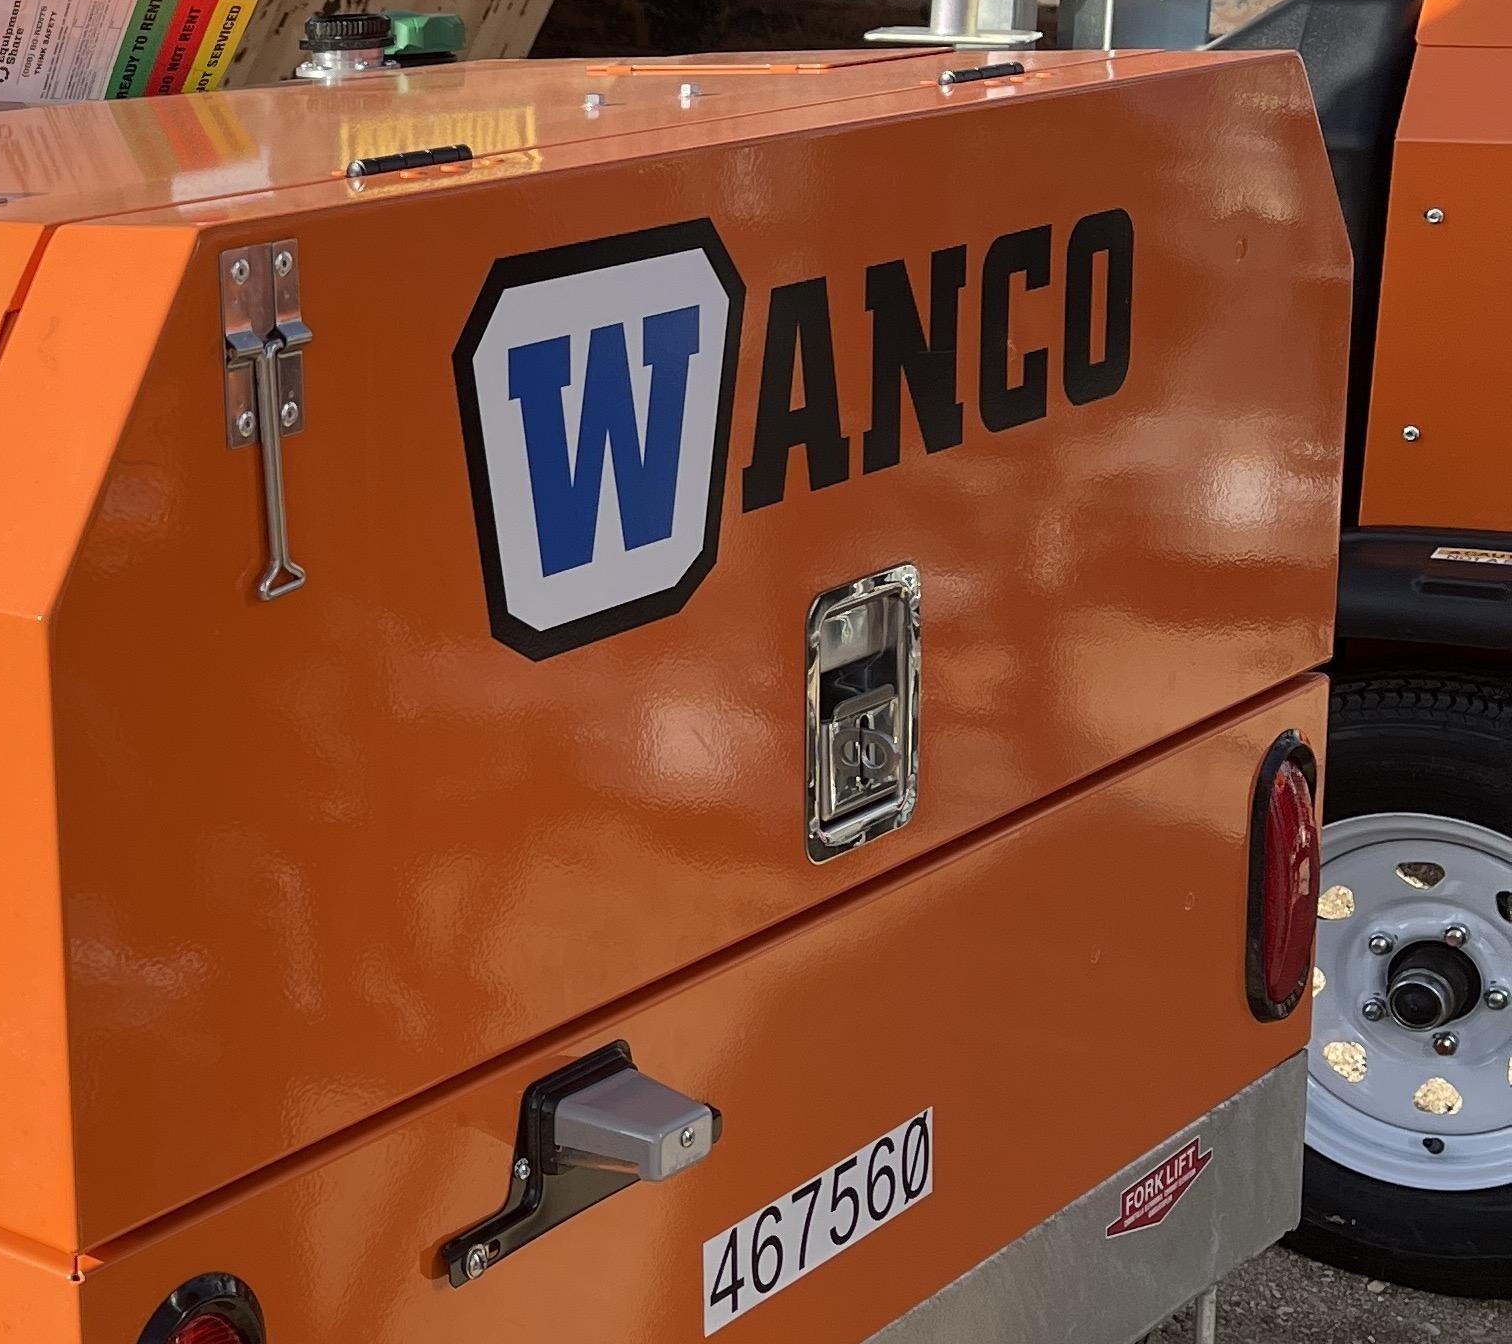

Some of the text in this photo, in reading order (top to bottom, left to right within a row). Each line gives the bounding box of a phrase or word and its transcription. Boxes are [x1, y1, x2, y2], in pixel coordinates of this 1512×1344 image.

[6, 27, 25, 65] Share
[34, 11, 57, 75] THINK SAFETY
[115, 55, 140, 100] READY
[133, 34, 148, 52] TO
[167, 45, 187, 72] NOT
[178, 6, 202, 42] RENT
[208, 4, 242, 68] SERVICED
[506, 208, 1135, 579] WANCO
[1125, 1169, 1165, 1217] FORK
[1166, 1146, 1196, 1185] LIFT
